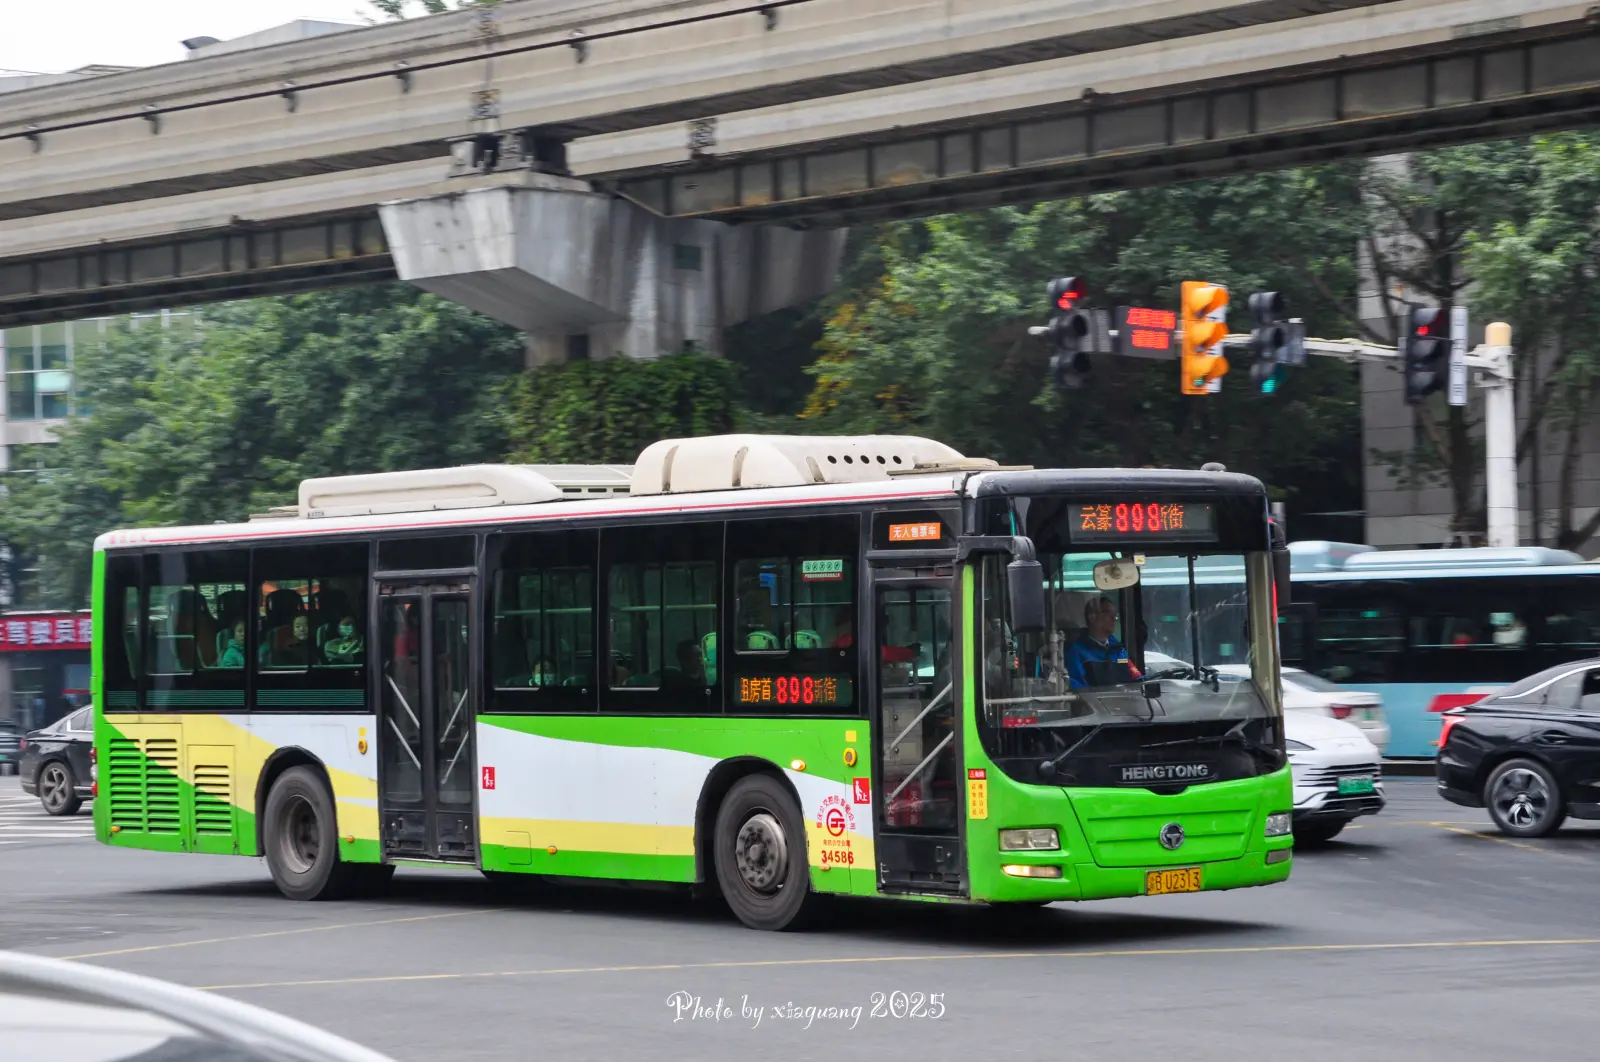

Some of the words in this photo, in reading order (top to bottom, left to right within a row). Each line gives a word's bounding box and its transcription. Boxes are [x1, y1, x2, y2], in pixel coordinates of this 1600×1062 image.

[1115, 502, 1160, 532] 898
[893, 525, 936, 538] 无人售票车
[776, 676, 814, 704] 898
[1122, 764, 1209, 780] HENGTONG
[821, 850, 855, 865] 34586
